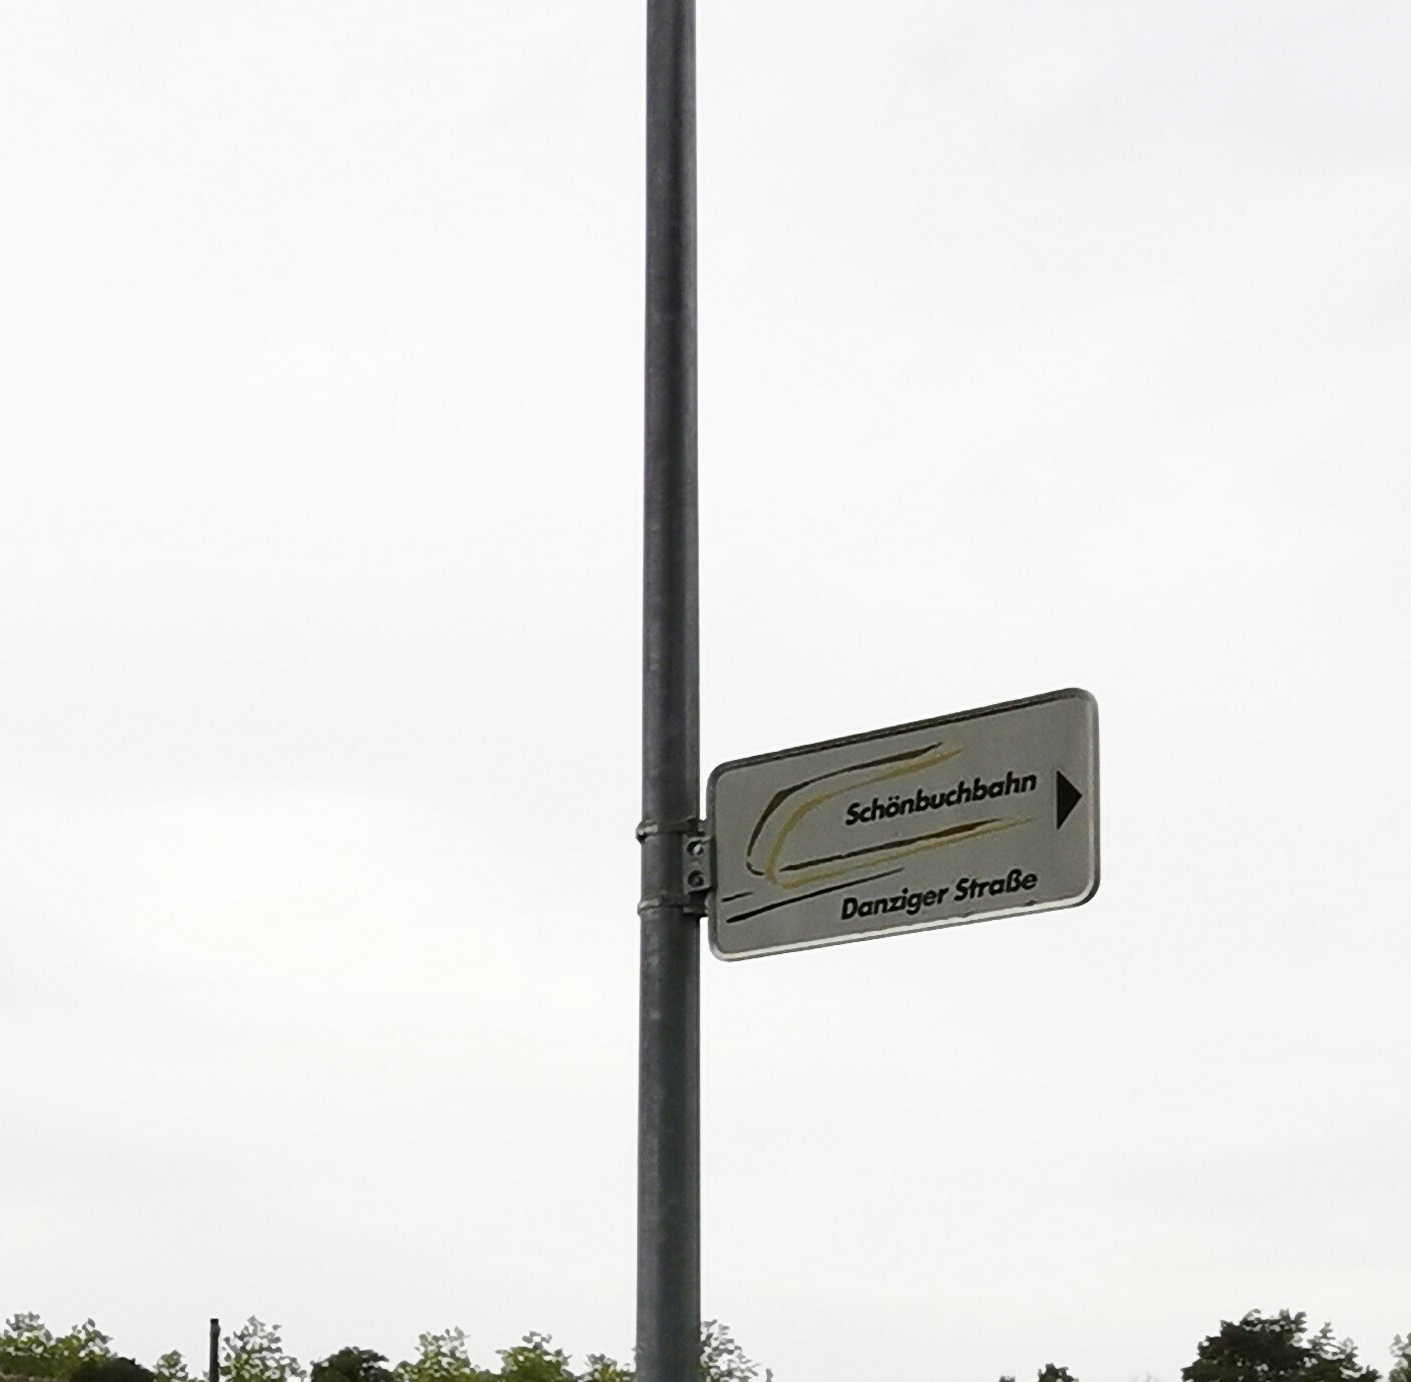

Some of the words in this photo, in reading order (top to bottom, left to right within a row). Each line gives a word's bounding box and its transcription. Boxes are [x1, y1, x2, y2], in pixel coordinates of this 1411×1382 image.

[845, 770, 1038, 826] Schönbuchbahn
[841, 887, 950, 920] Danziger
[953, 868, 1039, 902] Straße
